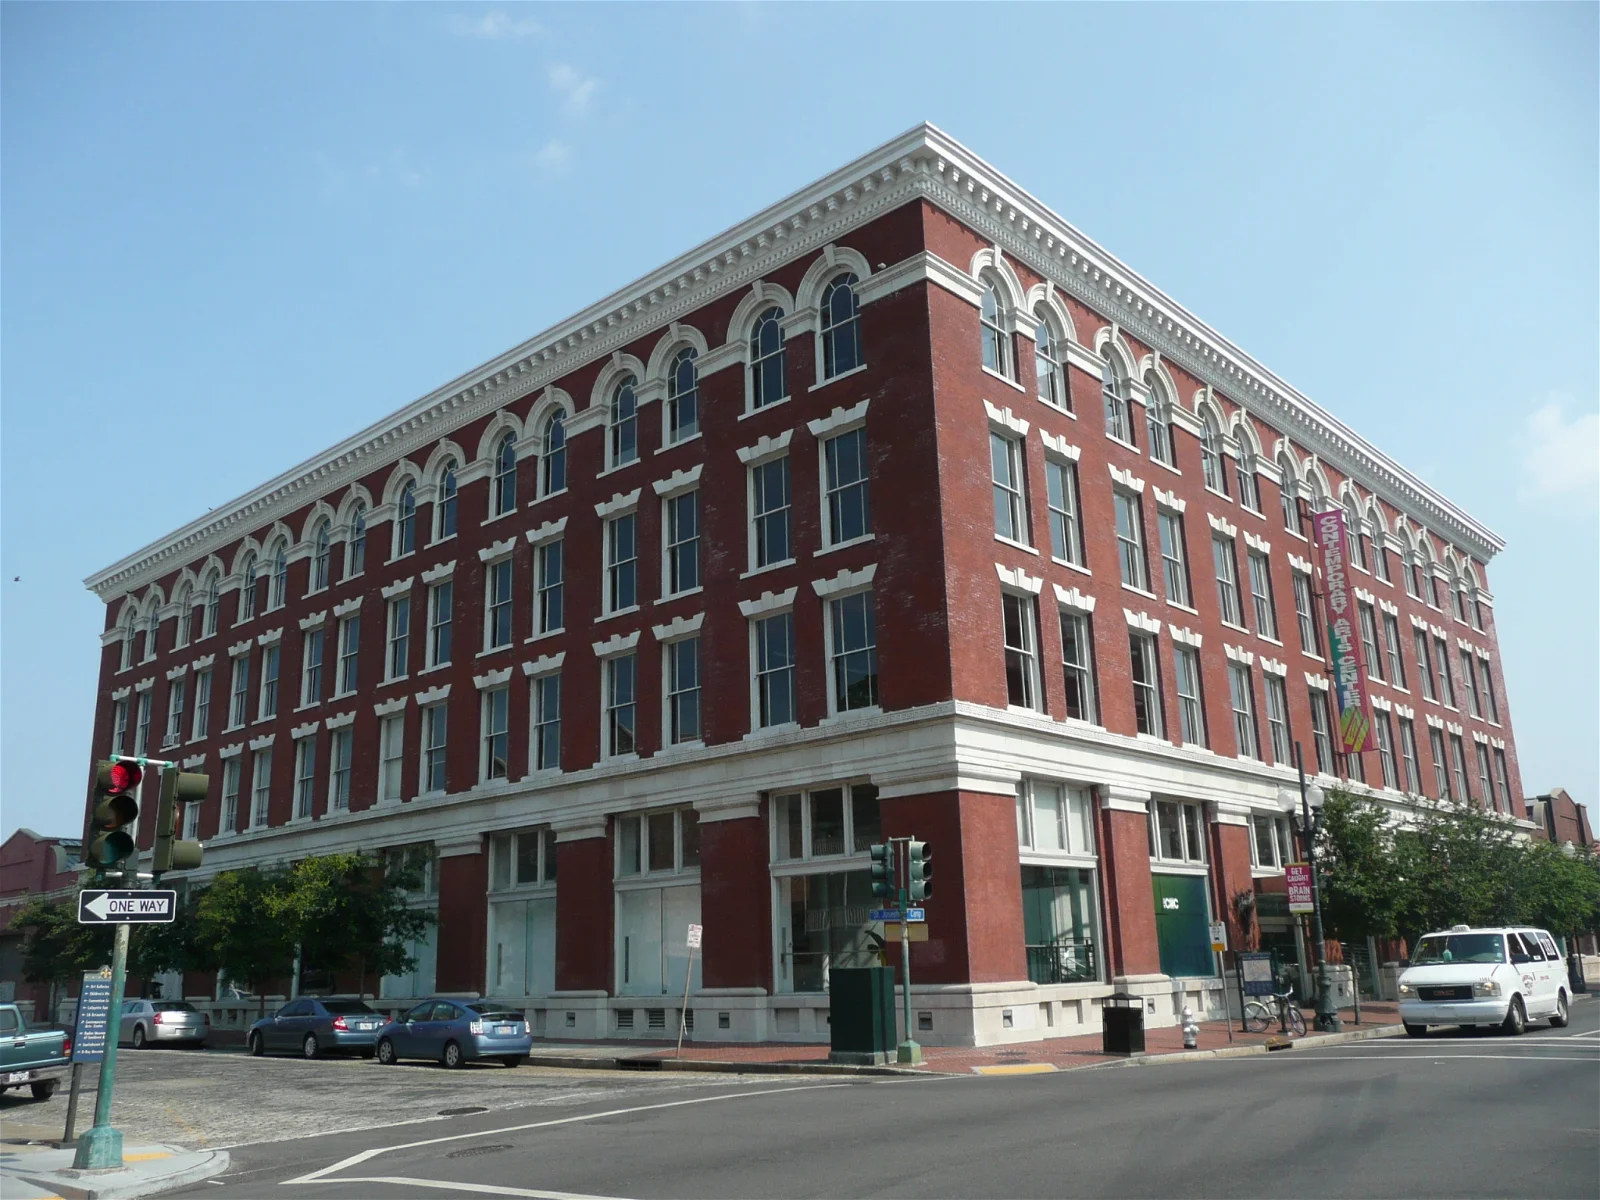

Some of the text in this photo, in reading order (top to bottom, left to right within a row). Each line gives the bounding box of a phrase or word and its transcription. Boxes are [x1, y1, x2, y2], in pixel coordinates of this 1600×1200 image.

[1319, 515, 1361, 708] CONTEMPORARY ARTS CENTER
[1291, 867, 1303, 875] GET
[1287, 874, 1309, 882] CAUGHT
[1288, 885, 1311, 895] BRAIN
[109, 900, 165, 912] ONE WAY
